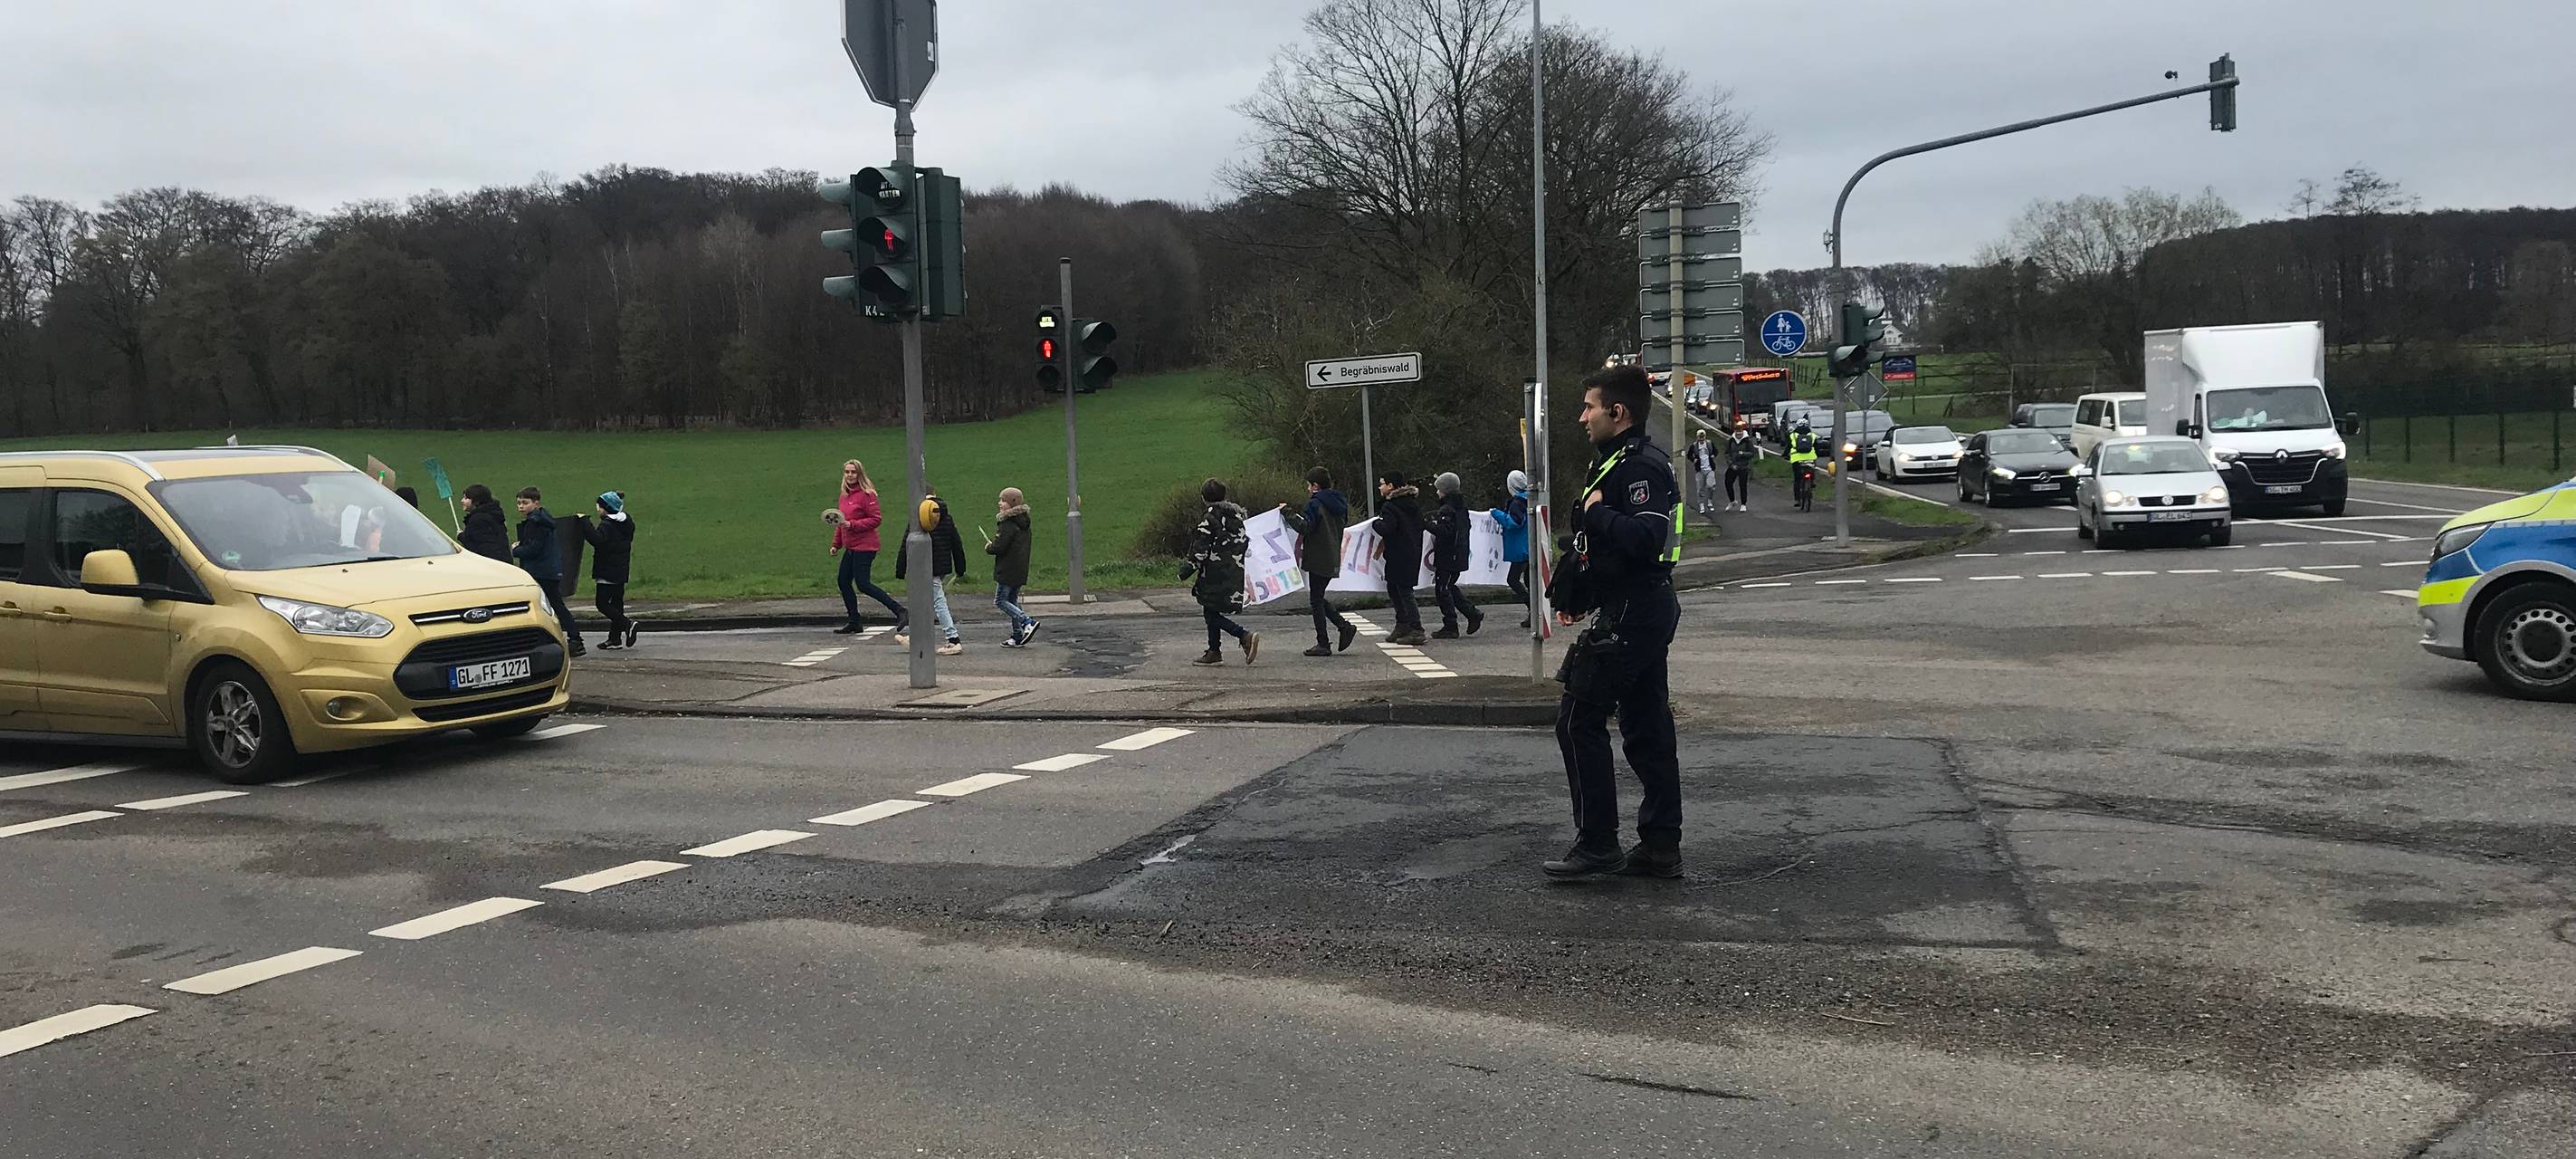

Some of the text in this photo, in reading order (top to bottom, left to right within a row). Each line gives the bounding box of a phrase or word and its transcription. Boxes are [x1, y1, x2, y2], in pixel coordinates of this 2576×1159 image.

[1340, 362, 1409, 378] Begräbniswald
[472, 610, 487, 618] Ford
[458, 668, 474, 685] GL
[482, 664, 497, 681] FF
[501, 659, 529, 678] 1271
